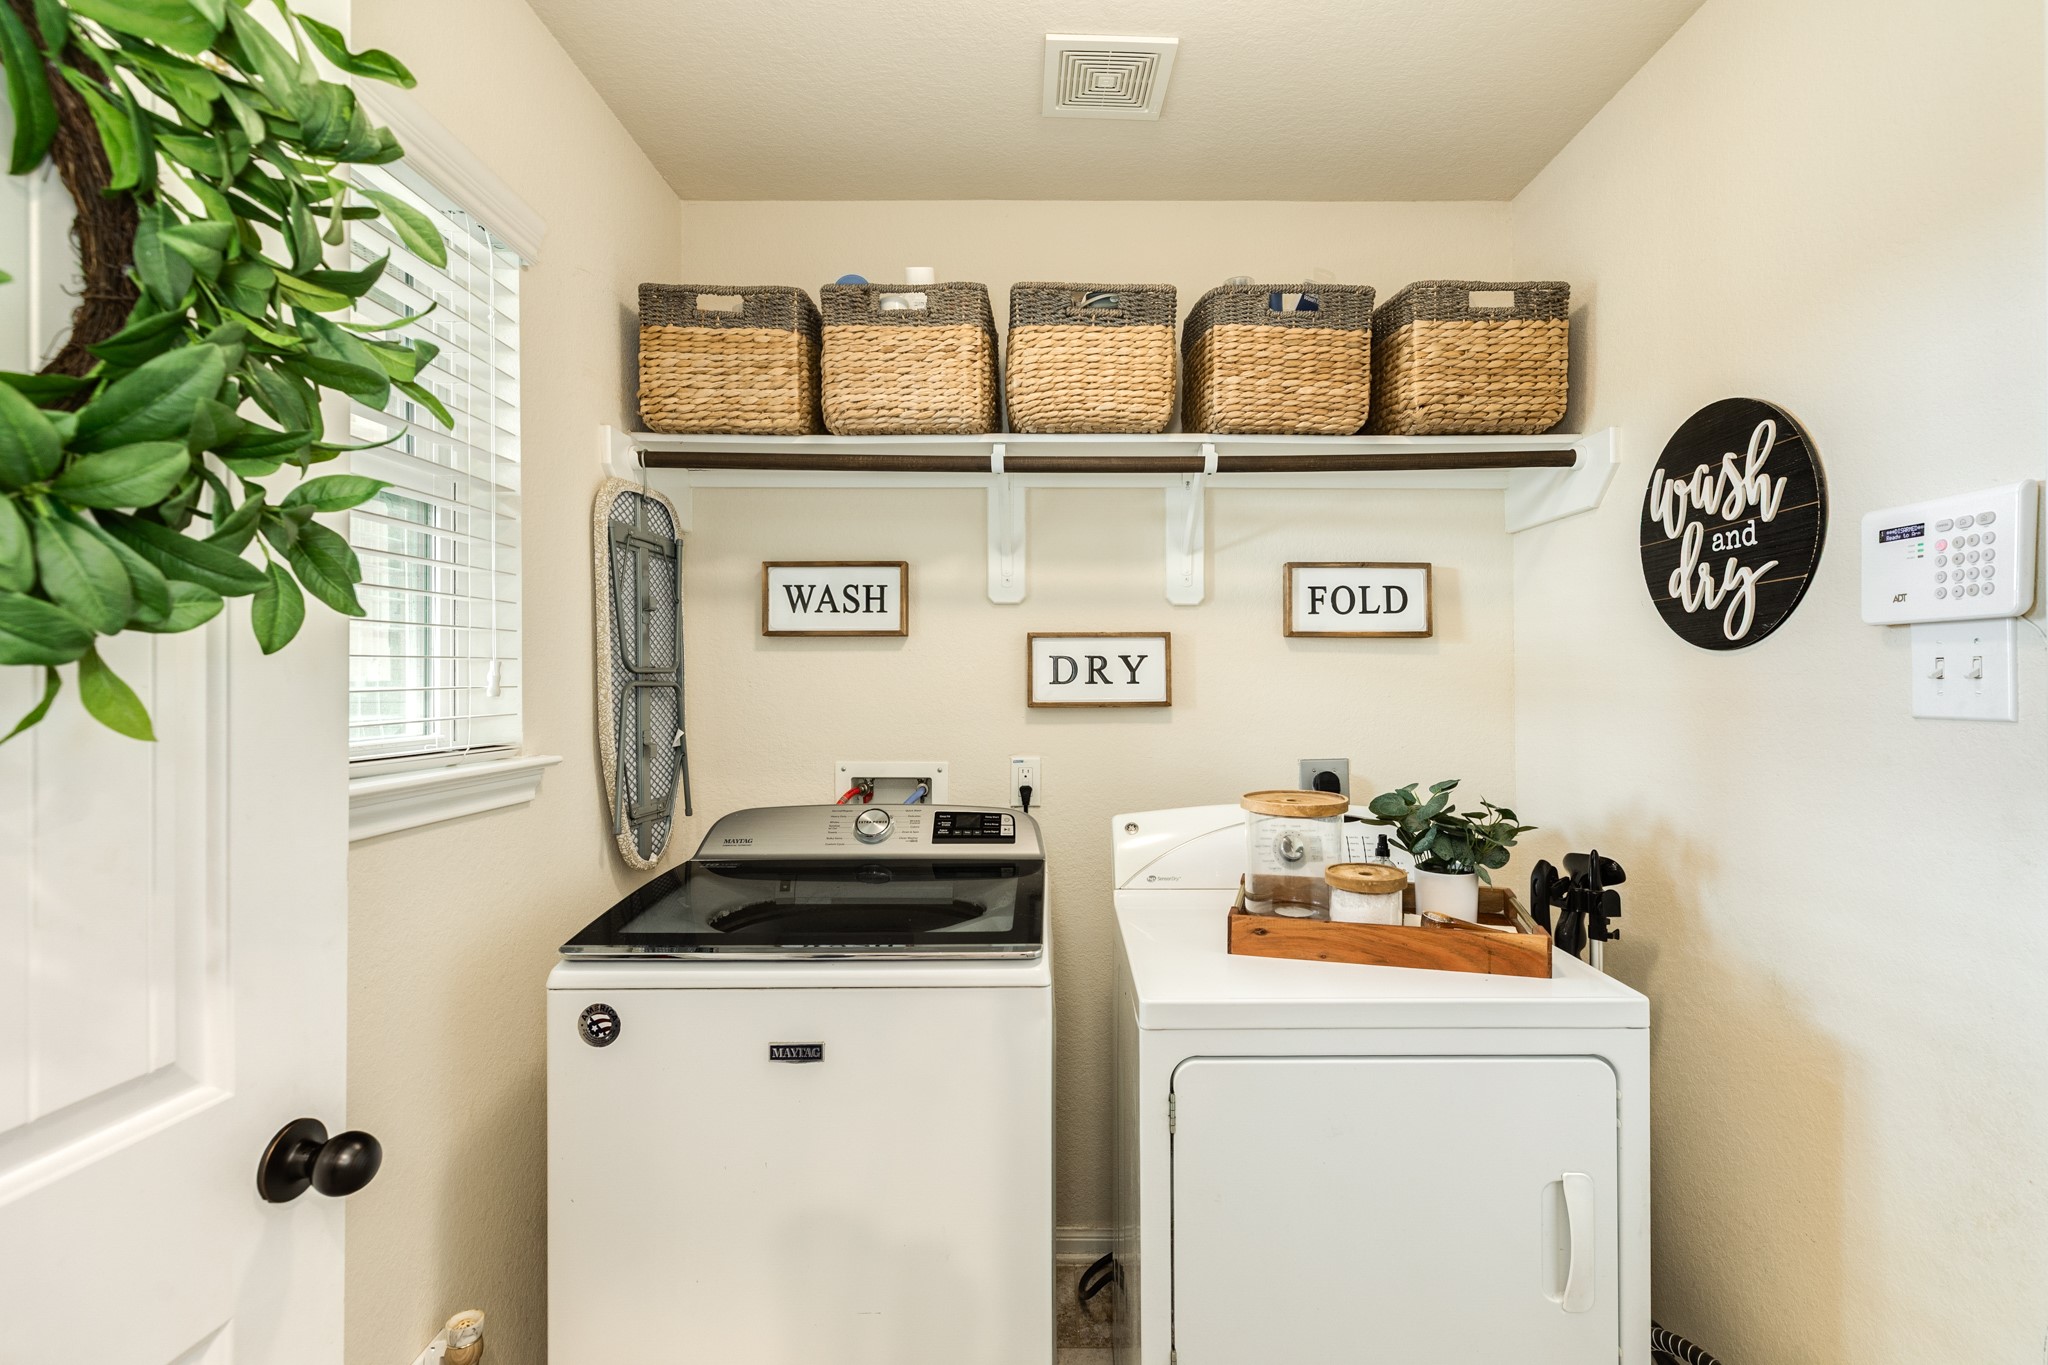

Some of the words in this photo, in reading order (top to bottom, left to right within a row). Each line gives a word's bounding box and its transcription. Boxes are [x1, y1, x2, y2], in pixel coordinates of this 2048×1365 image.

[1651, 419, 1788, 539] wash
[1712, 520, 1758, 551] and
[1669, 521, 1779, 640] dry
[783, 585, 887, 613] WASH
[1308, 586, 1407, 614] FOLD
[1893, 594, 1907, 603] ADT
[1049, 655, 1148, 684] DRY
[581, 1004, 618, 1021] AMERICA
[772, 1047, 820, 1058] MAYTAG
